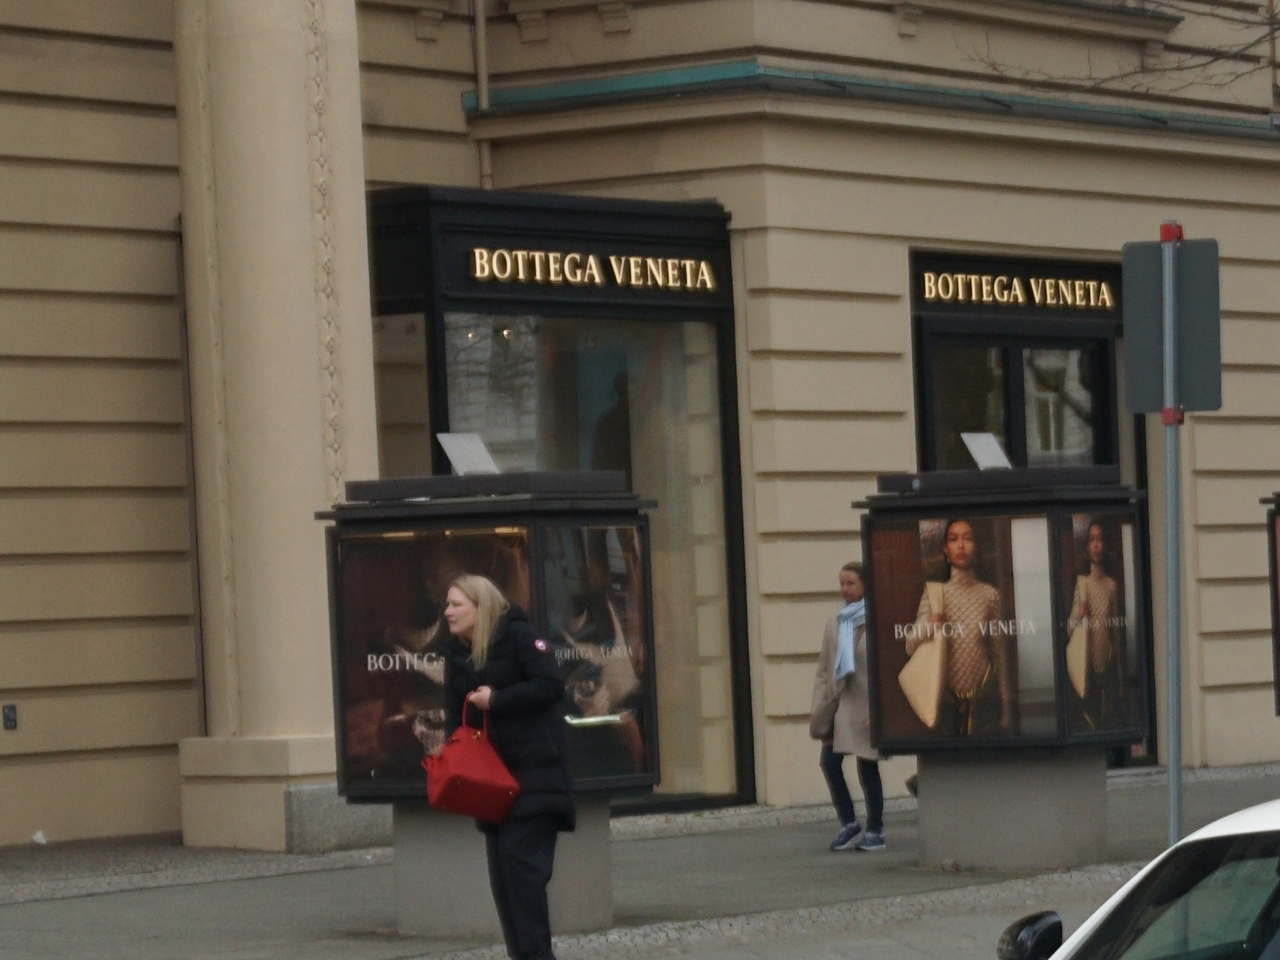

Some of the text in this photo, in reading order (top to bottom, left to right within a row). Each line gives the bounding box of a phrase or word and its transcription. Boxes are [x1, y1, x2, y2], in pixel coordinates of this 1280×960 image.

[473, 248, 714, 289] BOTTEGA VENETA
[923, 272, 1113, 307] BOTTEGA VENETA
[894, 619, 1036, 640] BOTTEGA VENETA
